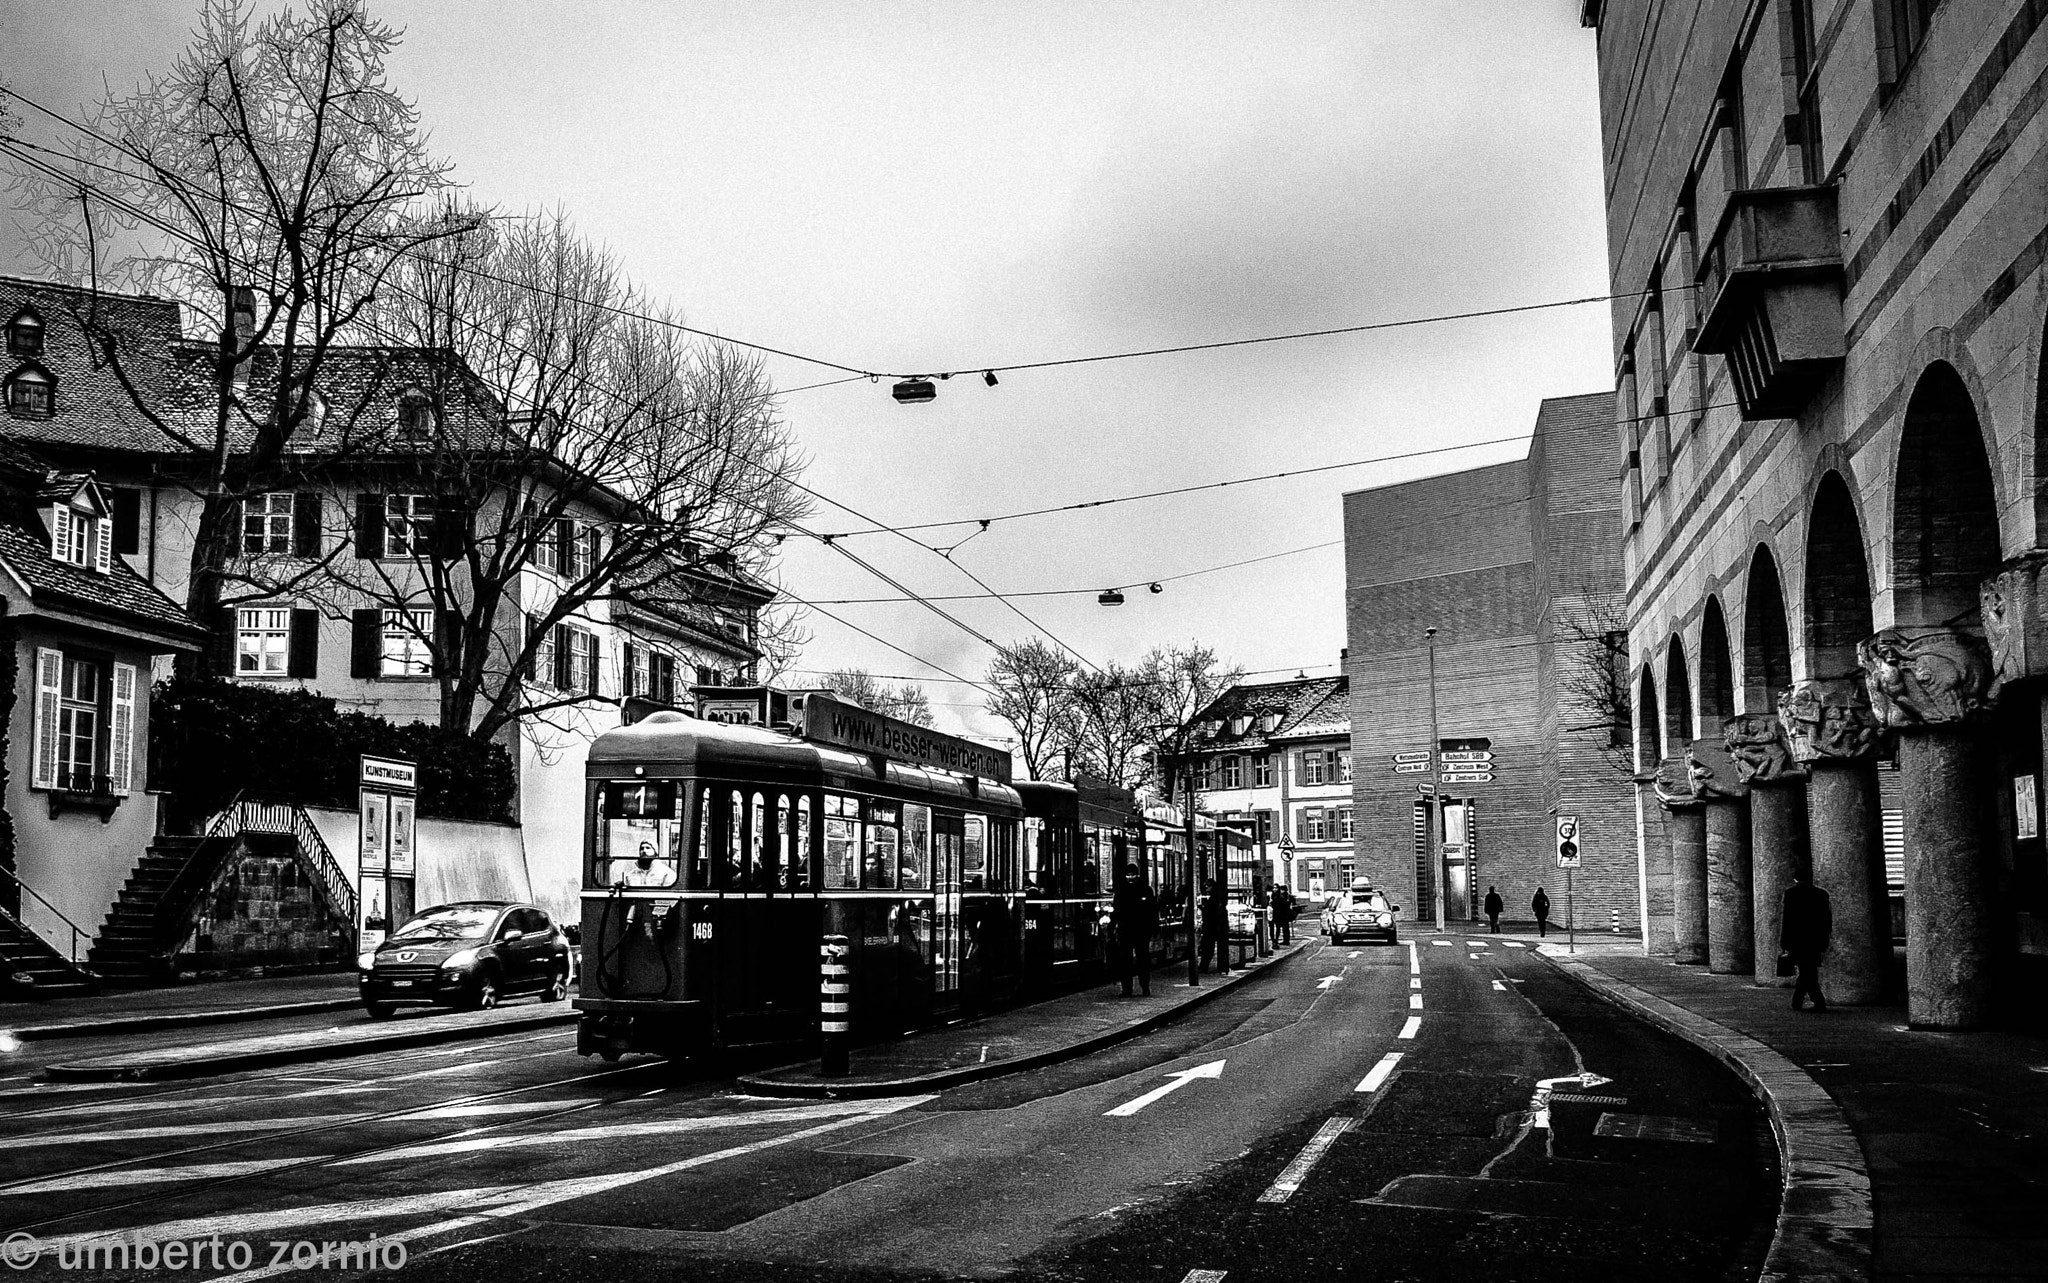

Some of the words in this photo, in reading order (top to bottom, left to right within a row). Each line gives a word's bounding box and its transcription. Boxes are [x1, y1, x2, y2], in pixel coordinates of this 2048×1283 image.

[832, 711, 1000, 777] www.besser-werben.ch
[365, 763, 413, 782] KUNSTMUSEUM
[634, 786, 646, 815] 1
[692, 922, 713, 940] 1468
